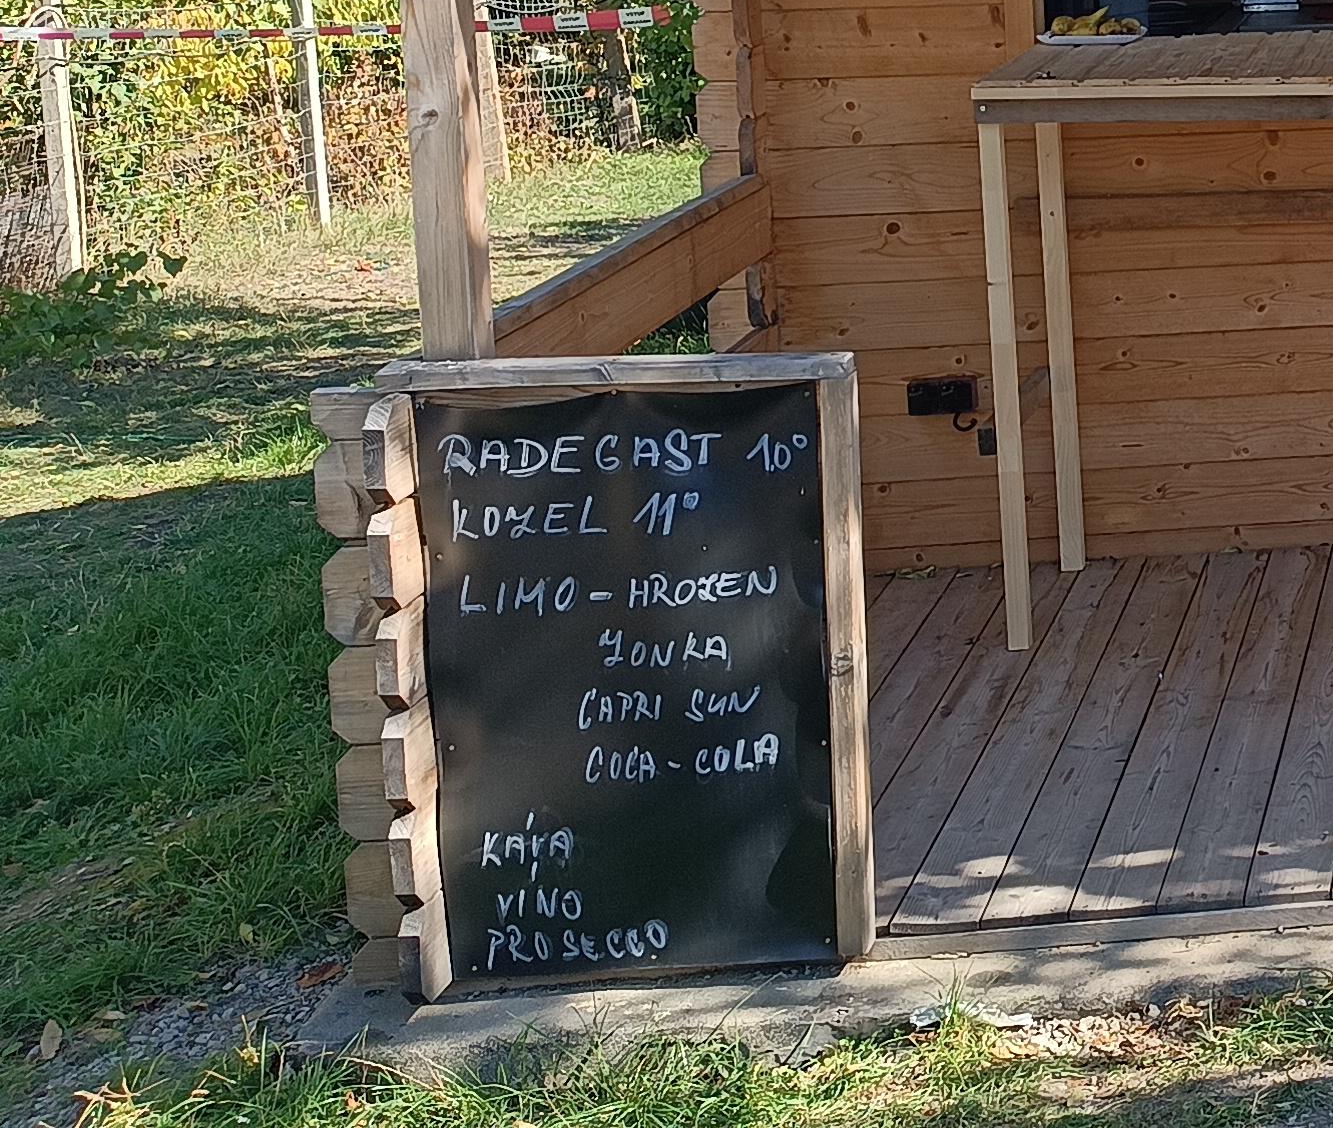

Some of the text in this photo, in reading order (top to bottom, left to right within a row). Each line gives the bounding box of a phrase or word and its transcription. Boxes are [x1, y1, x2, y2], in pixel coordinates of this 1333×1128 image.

[437, 428, 723, 476] RADEGAST
[452, 495, 608, 542] KOZEL
[459, 565, 777, 617] LIMO HROZEN
[578, 684, 760, 731] CAPRI SUN
[481, 811, 574, 868] KÁVA
[487, 919, 669, 970] PROSECCO
